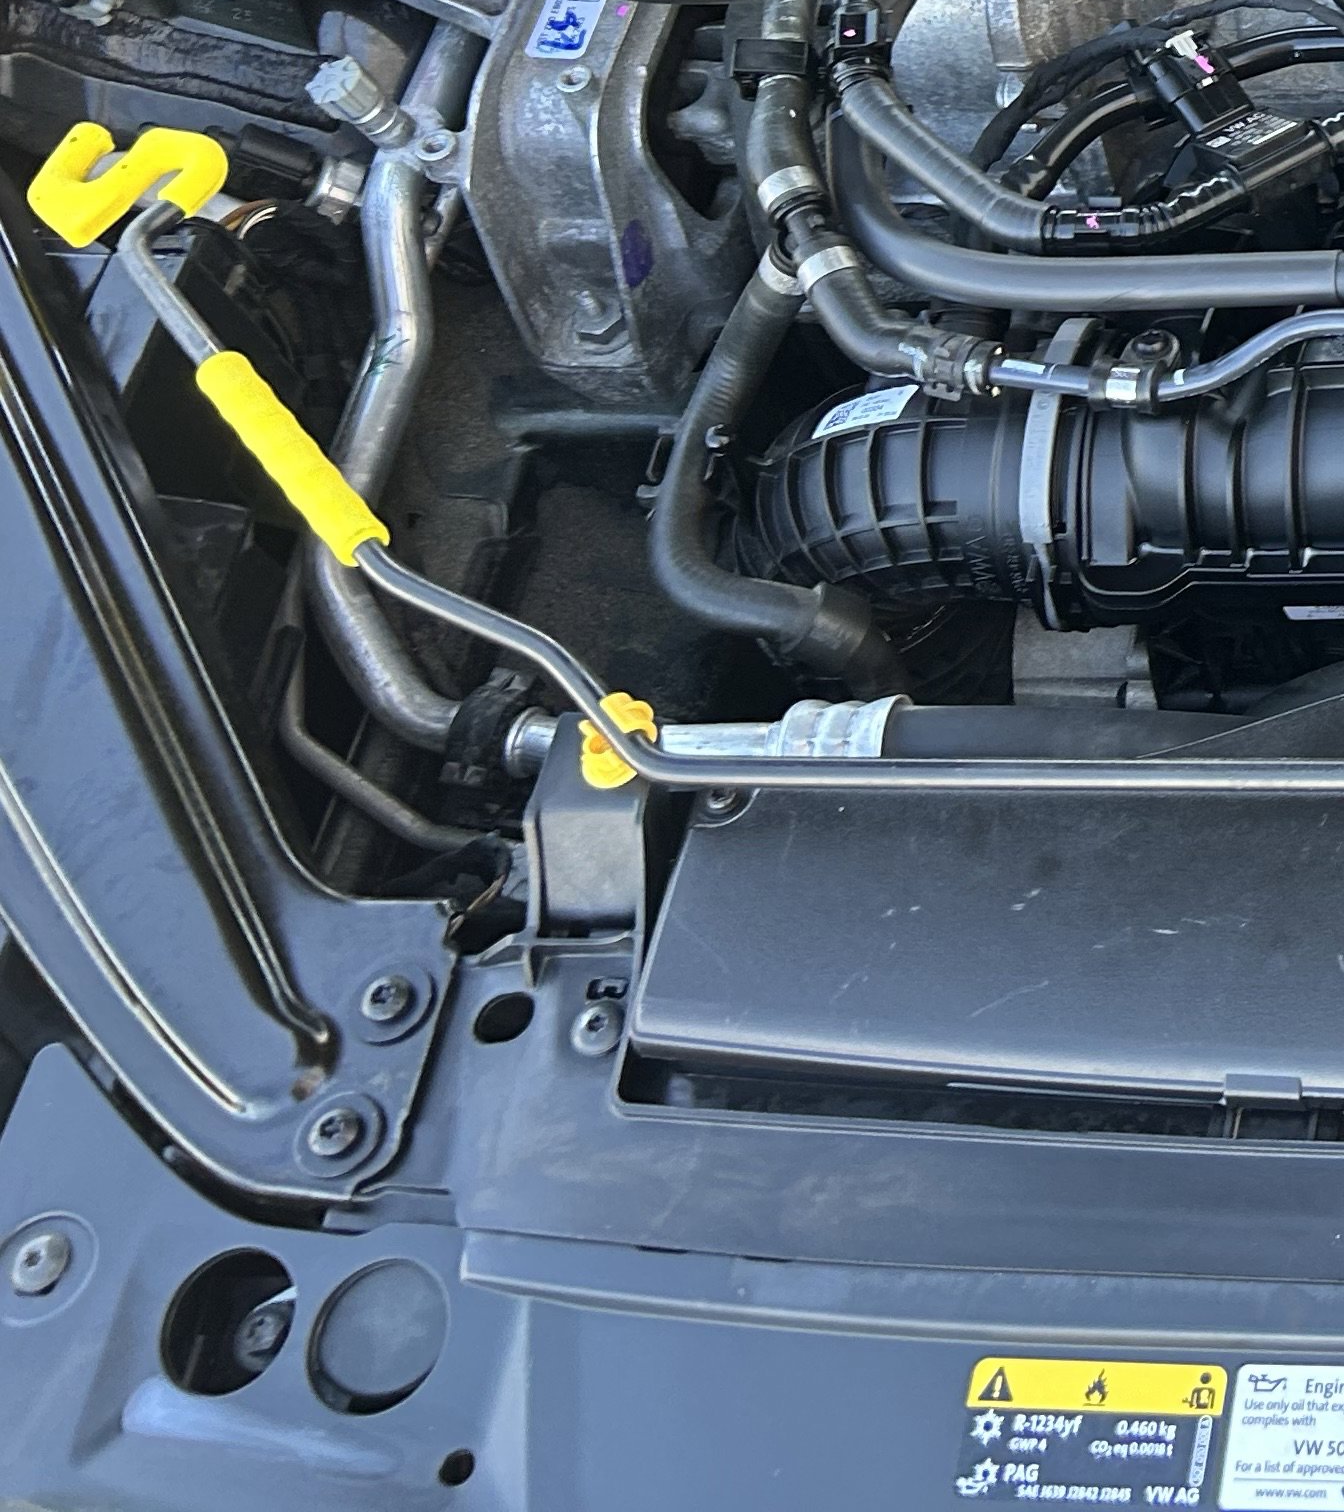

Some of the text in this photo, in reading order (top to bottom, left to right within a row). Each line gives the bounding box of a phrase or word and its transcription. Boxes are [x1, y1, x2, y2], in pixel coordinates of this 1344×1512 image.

[1244, 1398, 1264, 1410] Use
[1266, 1399, 1290, 1414] only
[1291, 1400, 1305, 1411] oil
[1306, 1400, 1329, 1412] that
[1013, 1414, 1083, 1439] R-1234yf
[1242, 1414, 1316, 1429] complies with
[1115, 1420, 1177, 1441] 0.460 kg
[1008, 1437, 1048, 1452] GWP 4
[1293, 1439, 1324, 1456] VW
[1003, 1464, 1040, 1483] PAG
[1235, 1460, 1253, 1472] For
[1254, 1463, 1262, 1472] a
[1264, 1460, 1281, 1473] list
[1282, 1460, 1296, 1474] of
[1016, 1485, 1039, 1500] SAE
[1144, 1486, 1200, 1505] VW AG
[1255, 1488, 1328, 1499] www.vw.com
